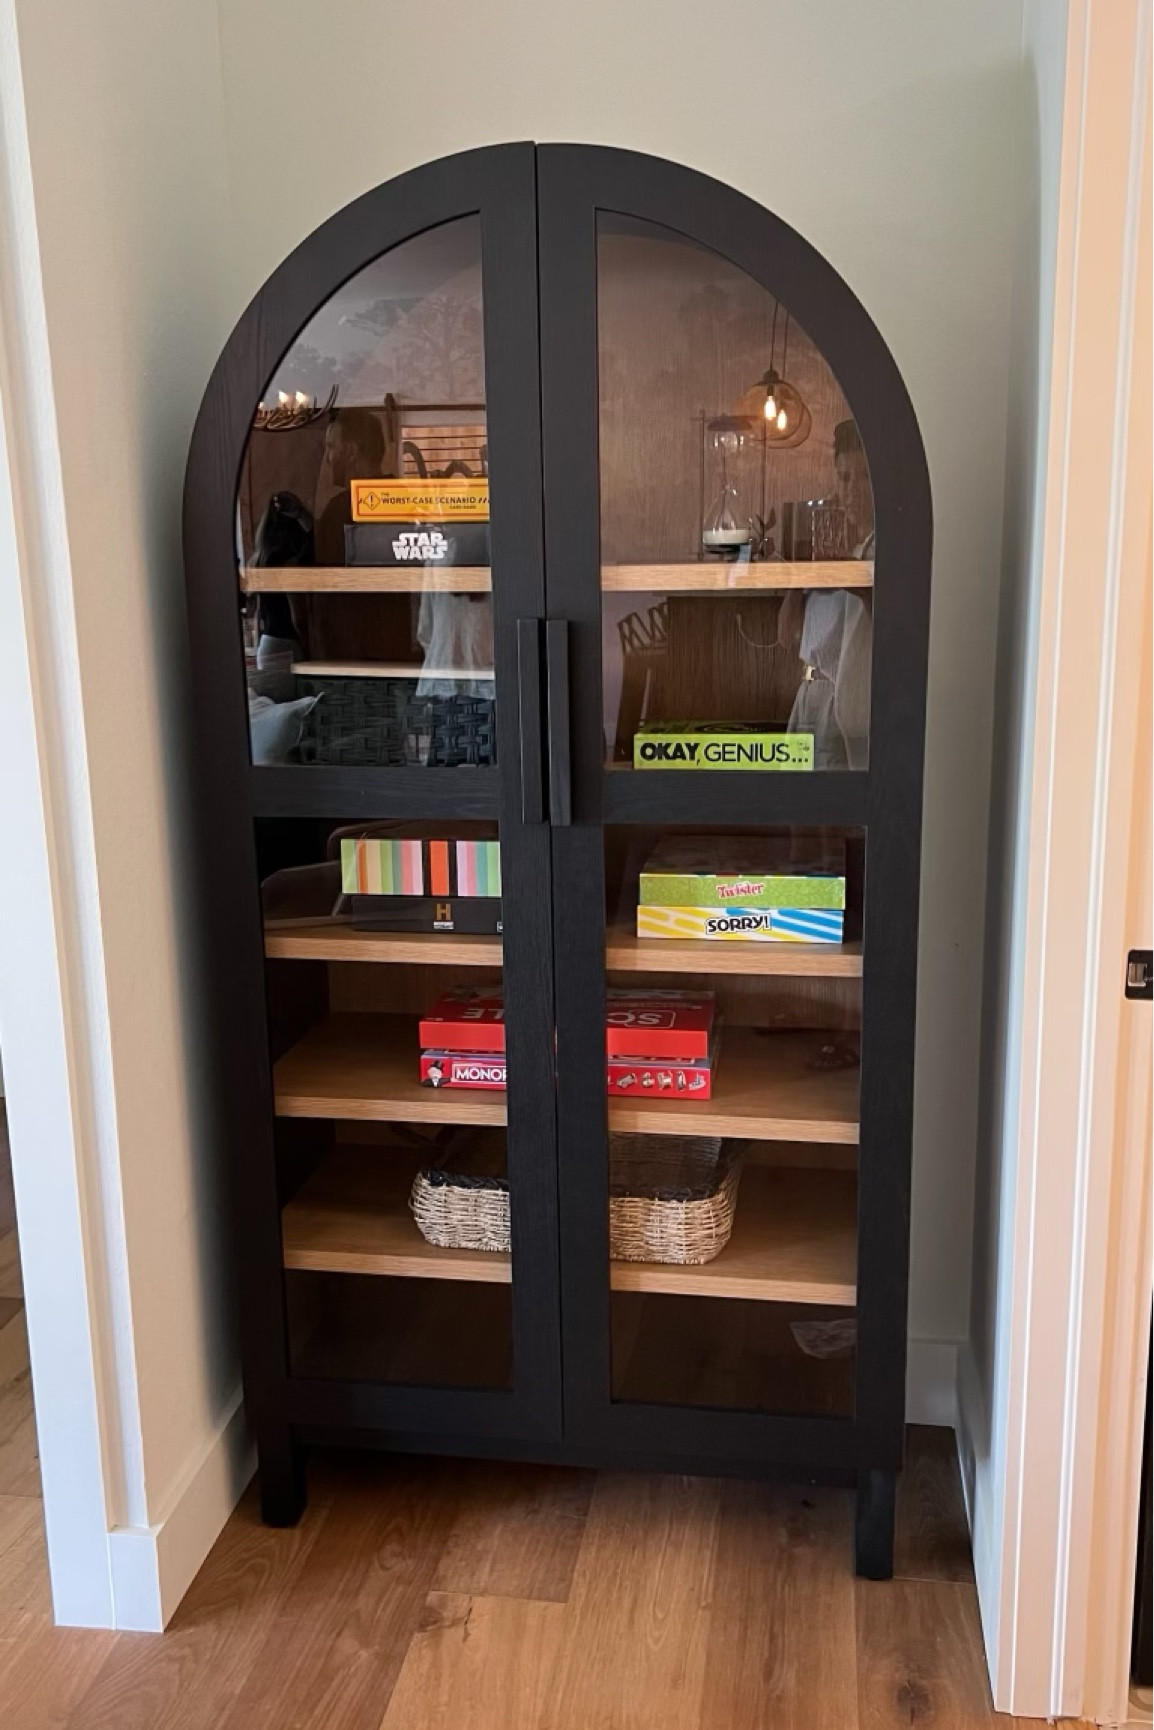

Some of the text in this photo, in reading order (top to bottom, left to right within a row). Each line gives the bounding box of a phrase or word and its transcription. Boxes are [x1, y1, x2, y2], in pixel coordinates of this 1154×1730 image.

[436, 496, 477, 504] SCENARIO
[391, 532, 448, 547] STAR
[392, 545, 449, 560] WARS
[639, 742, 809, 766] OKAY, GENIUS...
[717, 883, 764, 899] Twister
[436, 903, 452, 921] H
[708, 915, 769, 933] SORRY!
